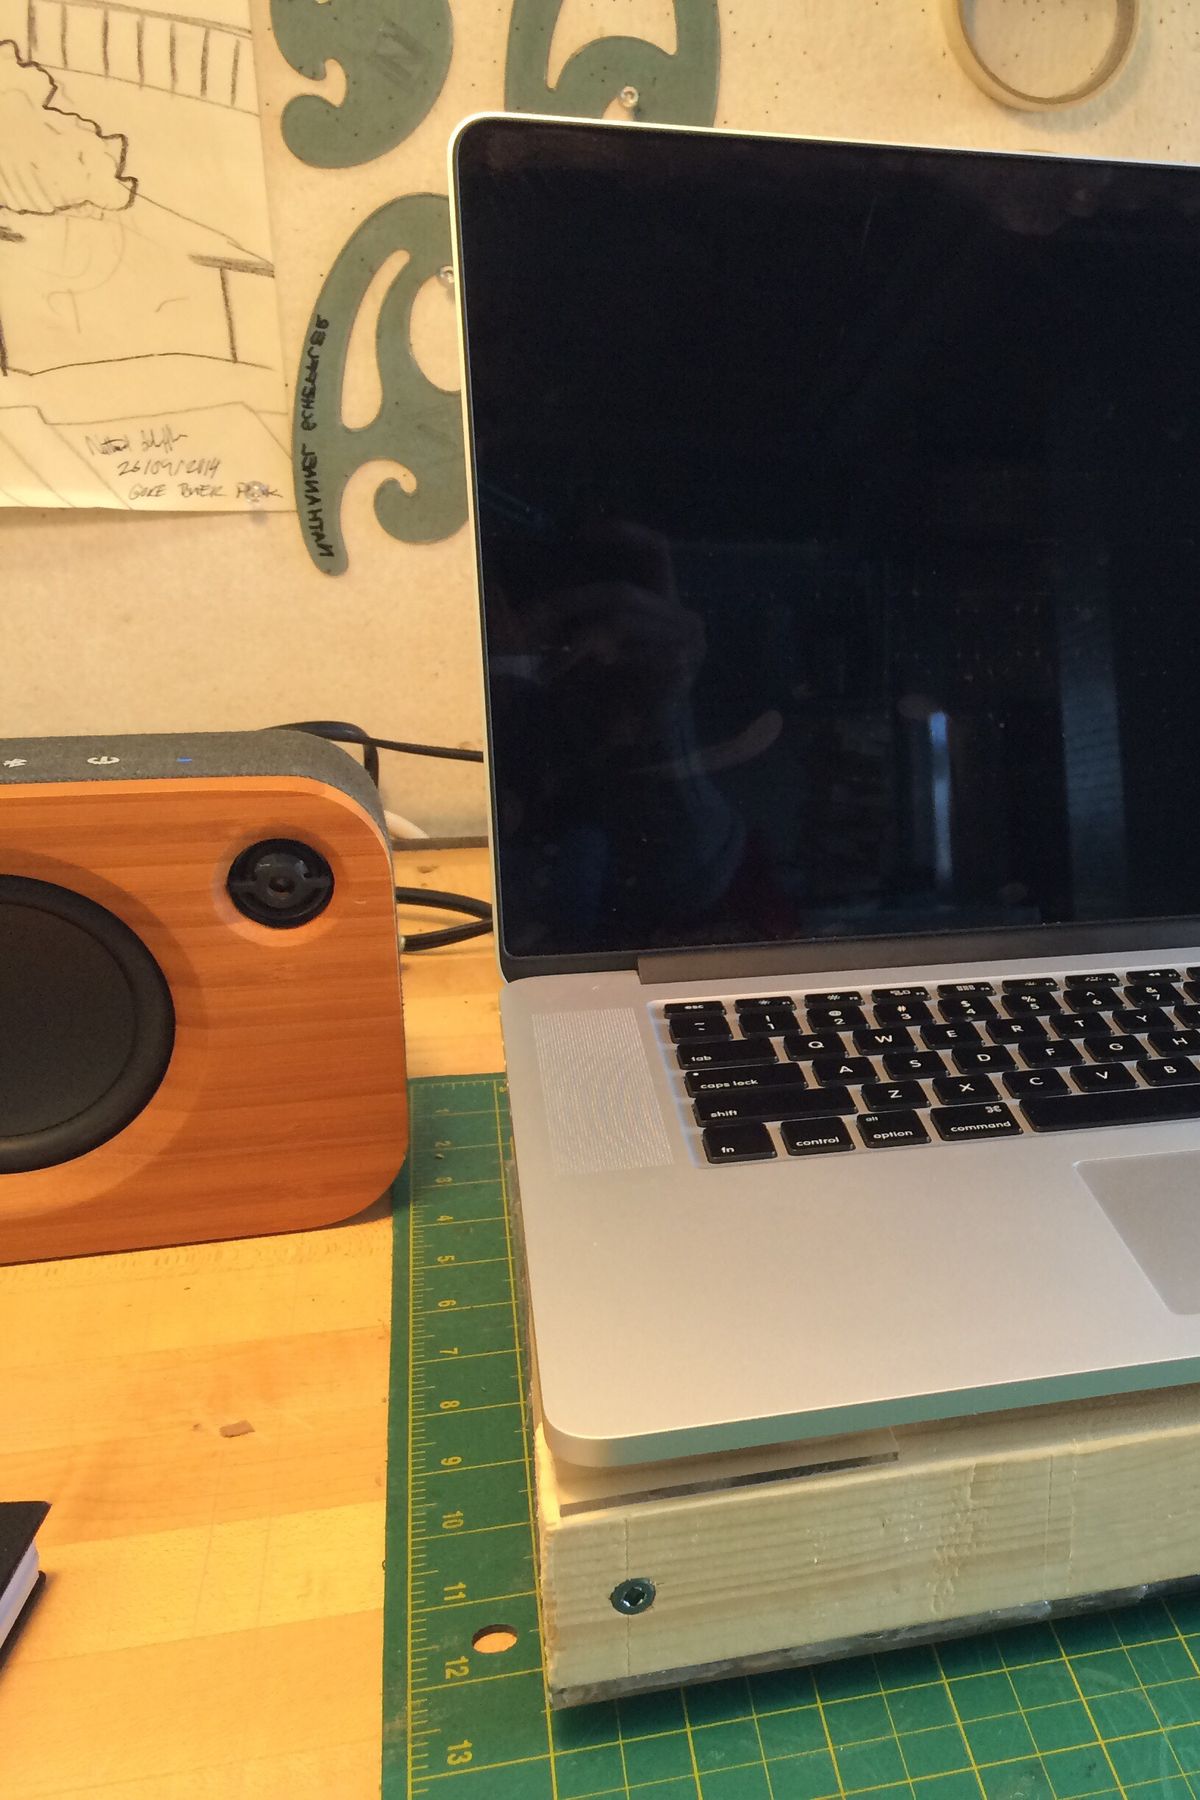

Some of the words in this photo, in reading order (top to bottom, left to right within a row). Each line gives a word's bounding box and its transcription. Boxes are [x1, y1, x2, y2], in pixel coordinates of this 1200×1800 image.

[1021, 995, 1037, 1003] %
[1136, 1014, 1147, 1023] Y
[1074, 1019, 1084, 1028] T
[1010, 1024, 1024, 1033] R
[946, 1029, 958, 1038] E
[874, 1034, 893, 1044] W
[1172, 1037, 1188, 1046] H
[807, 1040, 825, 1049] Q
[1108, 1043, 1124, 1051] G
[1045, 1047, 1056, 1056] F
[976, 1053, 991, 1062] D
[909, 1059, 922, 1068] S
[839, 1065, 854, 1074] A
[1163, 1065, 1177, 1074] B
[1095, 1071, 1108, 1080] V
[1029, 1077, 1044, 1086] C
[959, 1083, 975, 1092] X
[887, 1089, 903, 1099] Z
[710, 1109, 738, 1118] shift
[950, 1120, 1012, 1132] command
[873, 1130, 913, 1140] option
[795, 1136, 840, 1147] control
[721, 1146, 735, 1154] fn
[437, 1255, 455, 1264] 5
[438, 1299, 457, 1308] 6
[440, 1347, 459, 1355] 7
[440, 1400, 460, 1409] 8
[441, 1456, 462, 1466] 9
[442, 1510, 464, 1529] 10
[443, 1582, 467, 1601] 11
[445, 1655, 470, 1680] 12
[446, 1739, 473, 1765] 13
